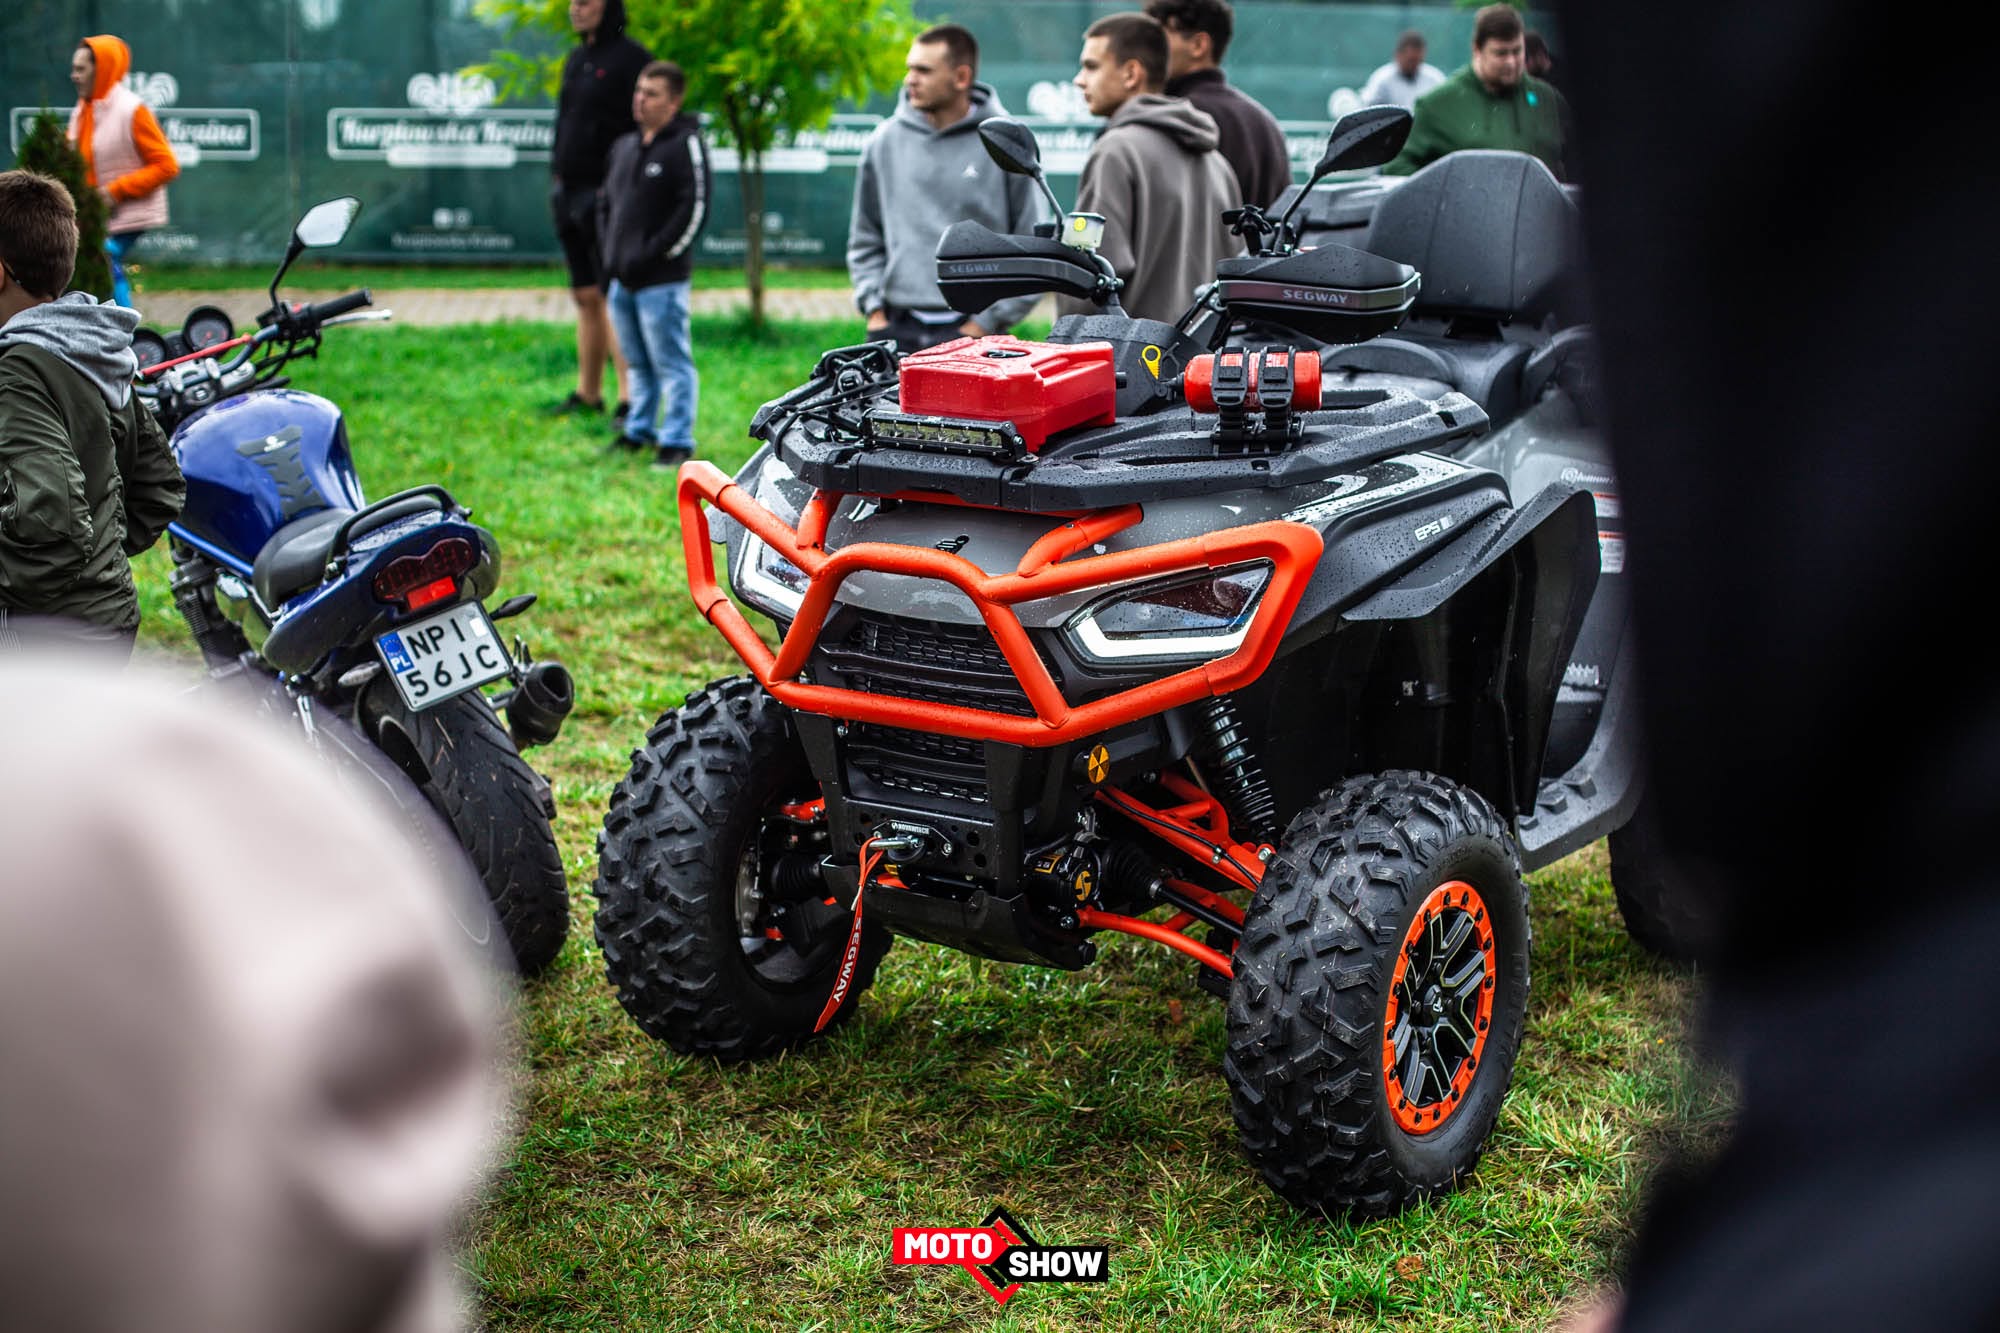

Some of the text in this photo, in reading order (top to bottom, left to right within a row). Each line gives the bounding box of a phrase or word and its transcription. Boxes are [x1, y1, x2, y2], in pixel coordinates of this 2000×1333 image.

[948, 263, 1000, 273] SEGWAY
[1282, 289, 1348, 304] SEGWAY
[1414, 520, 1441, 541] EPS
[406, 618, 466, 659] NPI
[390, 655, 411, 671] PL
[405, 644, 498, 697] 56JC
[833, 917, 861, 1002] SEGWAY
